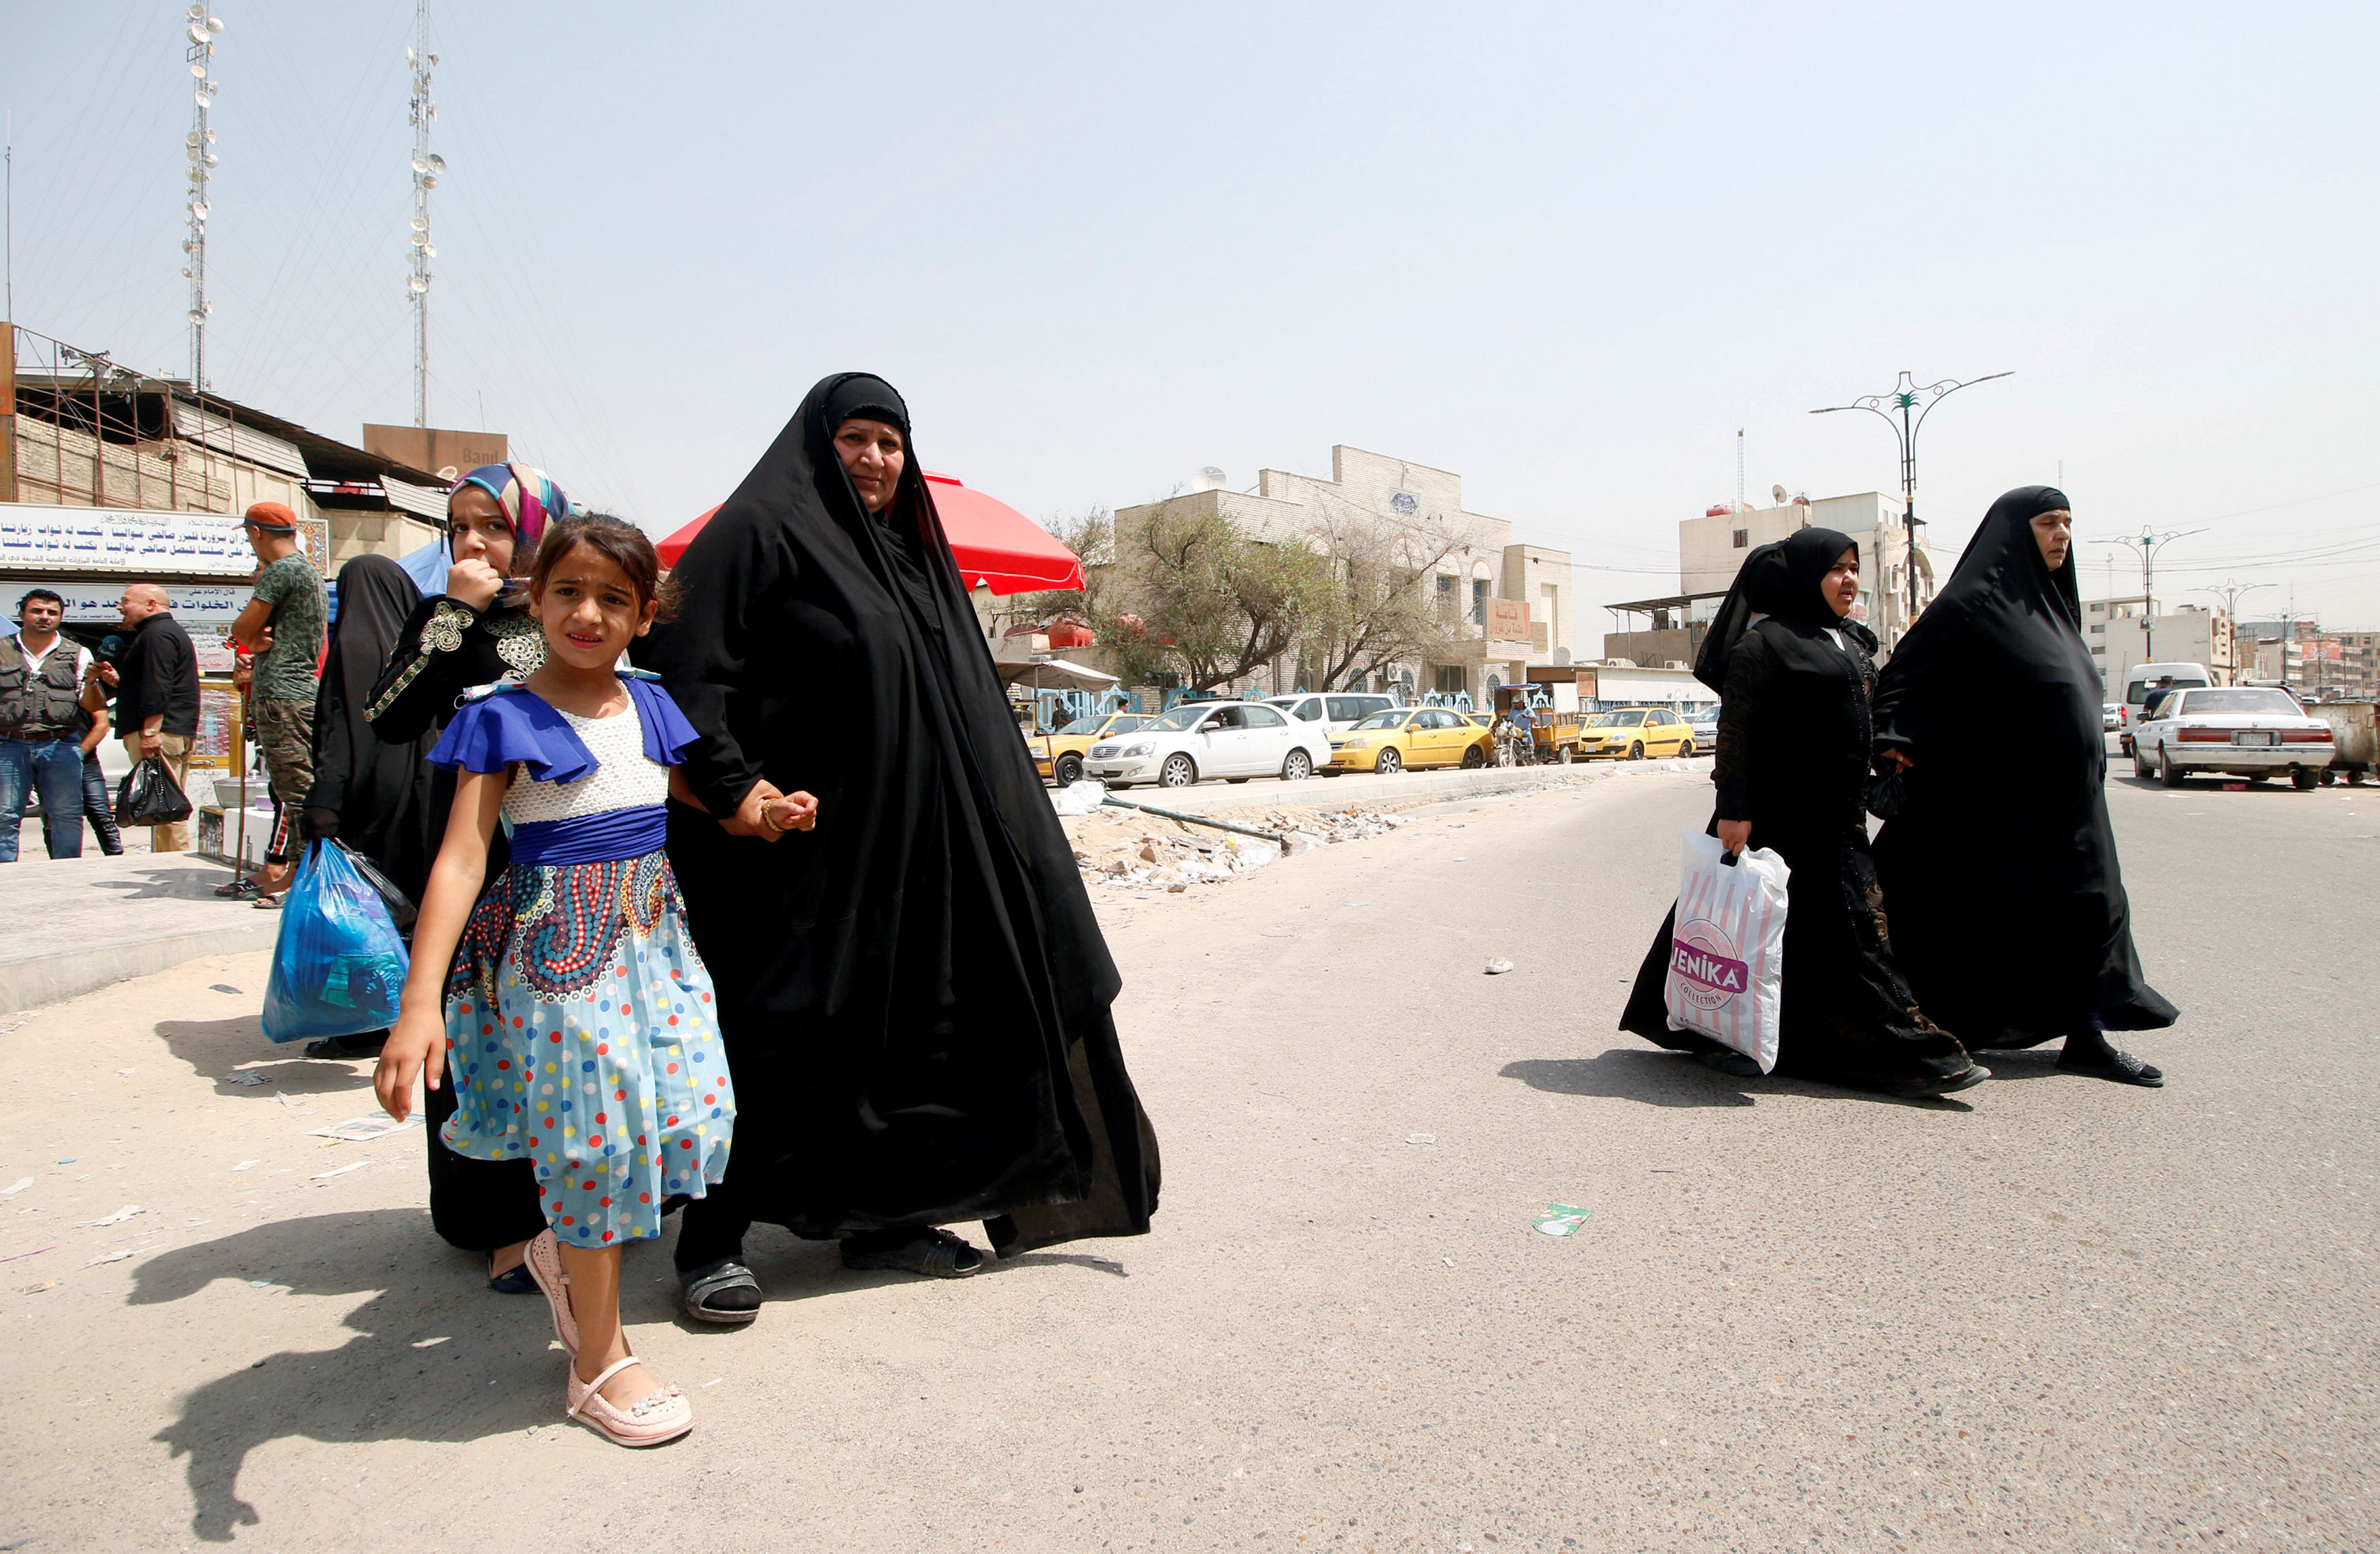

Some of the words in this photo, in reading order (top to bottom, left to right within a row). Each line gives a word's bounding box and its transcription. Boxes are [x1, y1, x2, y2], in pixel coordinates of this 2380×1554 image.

[463, 448, 498, 464] Band
[1, 522, 32, 535] زيارتنا
[38, 524, 62, 537] ثواب
[65, 526, 73, 535] له
[76, 526, 103, 539] يكتب
[112, 528, 143, 541] موالينا
[3, 537, 32, 547] صلتنا
[201, 532, 226, 544] يزورنا
[35, 539, 58, 551] ثواب
[63, 541, 70, 549] له
[74, 541, 97, 552] يكتب
[106, 541, 135, 554] موالينا
[170, 545, 196, 556] فليصل
[199, 545, 224, 555] صلتنا
[228, 547, 243, 558] على
[80, 598, 97, 610] هو
[182, 600, 233, 611] الخلوات
[1496, 605, 1517, 620] قاعة
[1490, 622, 1504, 635] غزوان
[1505, 624, 1511, 637] بن
[1680, 983, 1722, 1005] COLLECTION
